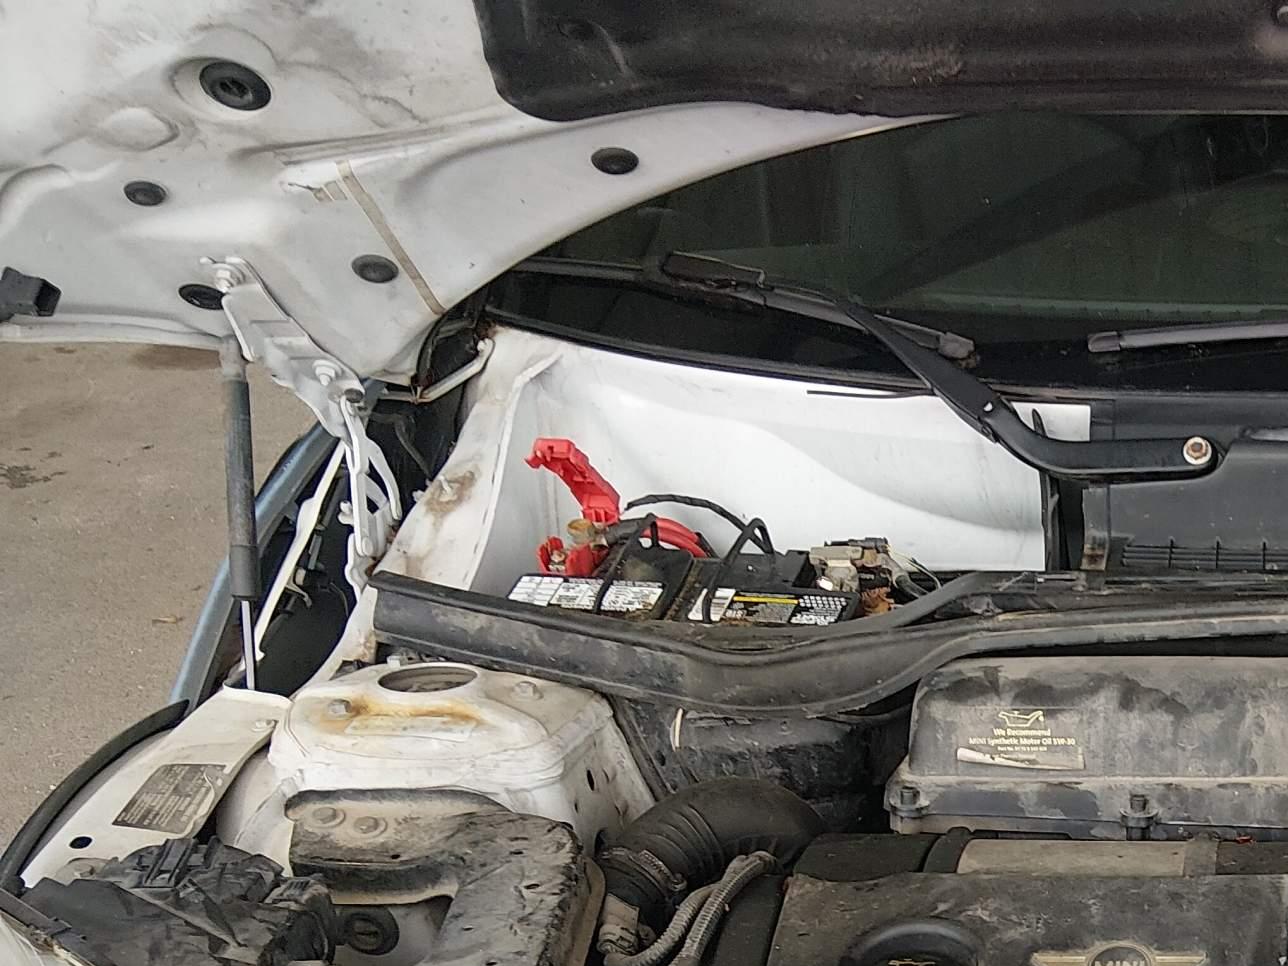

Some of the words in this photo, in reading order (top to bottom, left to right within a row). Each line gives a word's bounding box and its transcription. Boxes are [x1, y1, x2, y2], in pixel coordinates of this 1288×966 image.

[992, 728, 1006, 736] We
[1006, 728, 1051, 736] Recommend
[968, 737, 987, 745] MINI
[987, 737, 1019, 746] Synthetic
[1019, 737, 1041, 745] Motor
[1041, 737, 1052, 745] Oil
